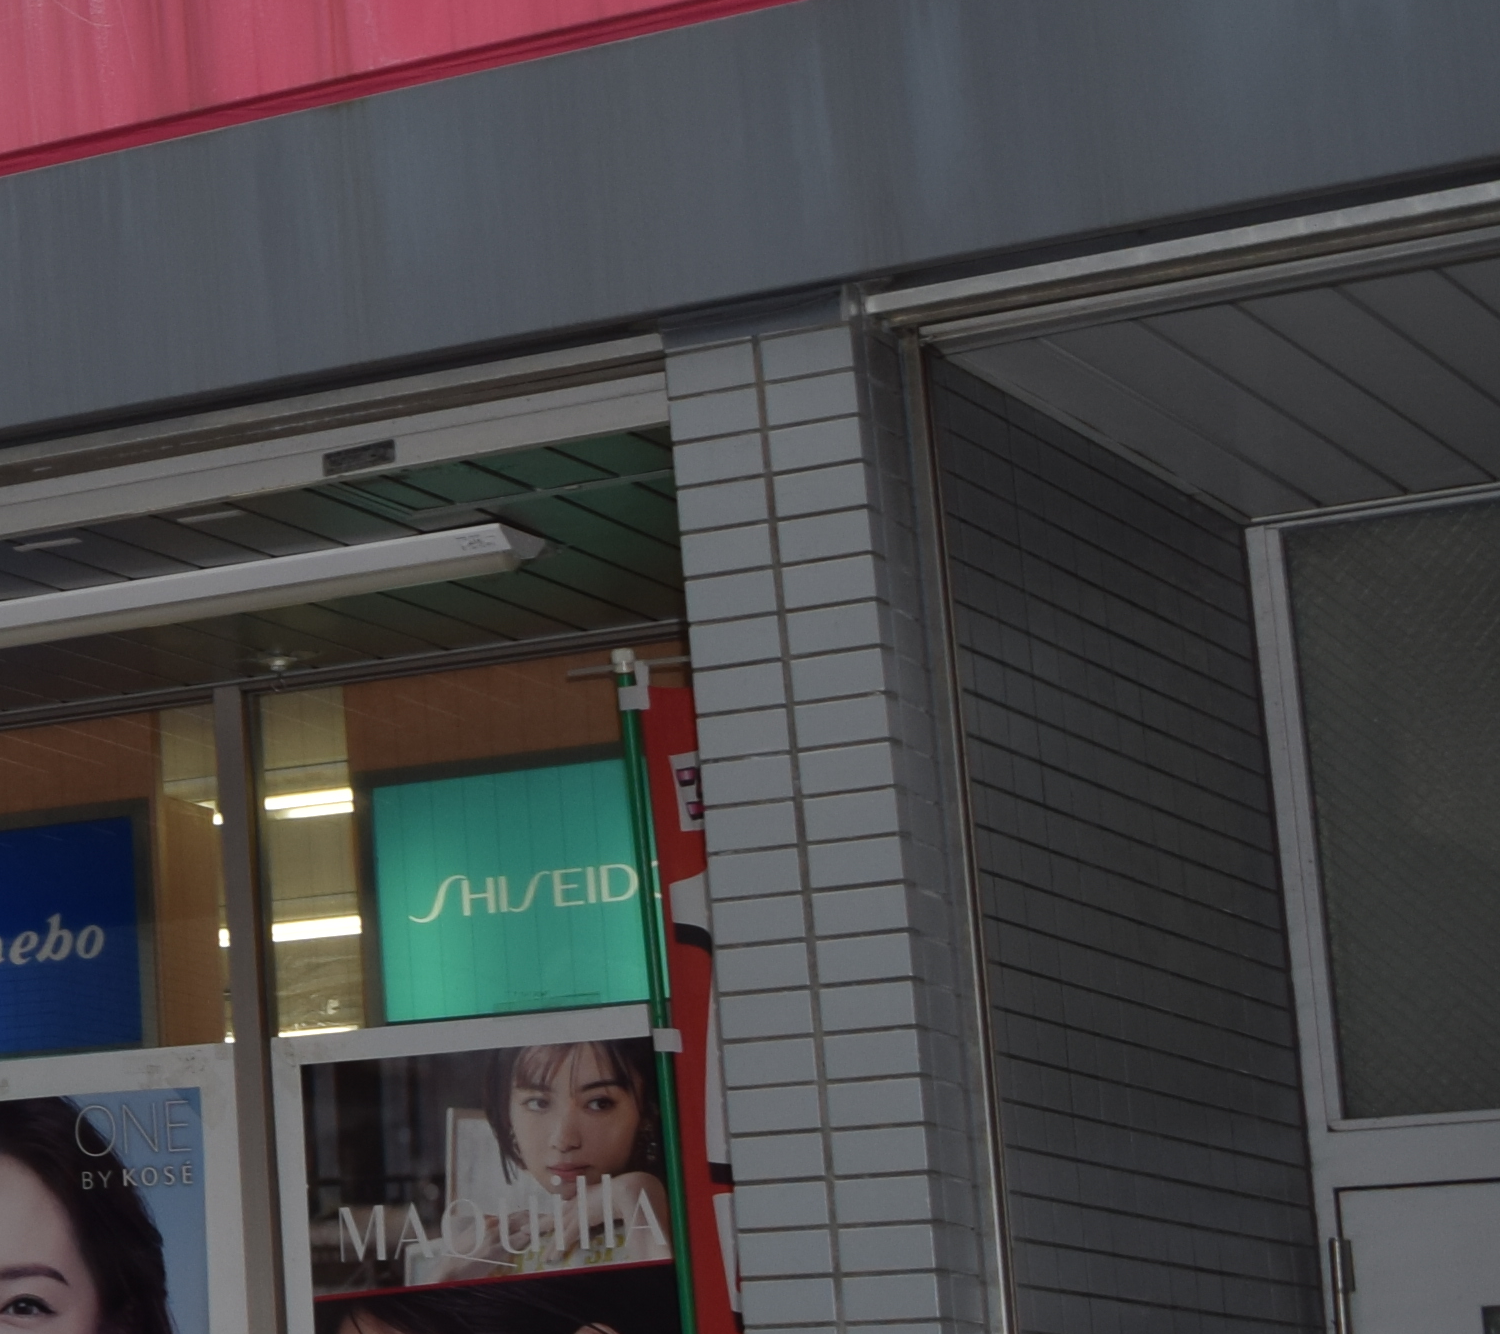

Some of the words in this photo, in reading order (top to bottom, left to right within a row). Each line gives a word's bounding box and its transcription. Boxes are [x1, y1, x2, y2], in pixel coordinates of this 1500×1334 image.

[75, 1100, 192, 1157] ONE
[81, 1170, 111, 1190] BY
[122, 1162, 194, 1188] KOSÉ
